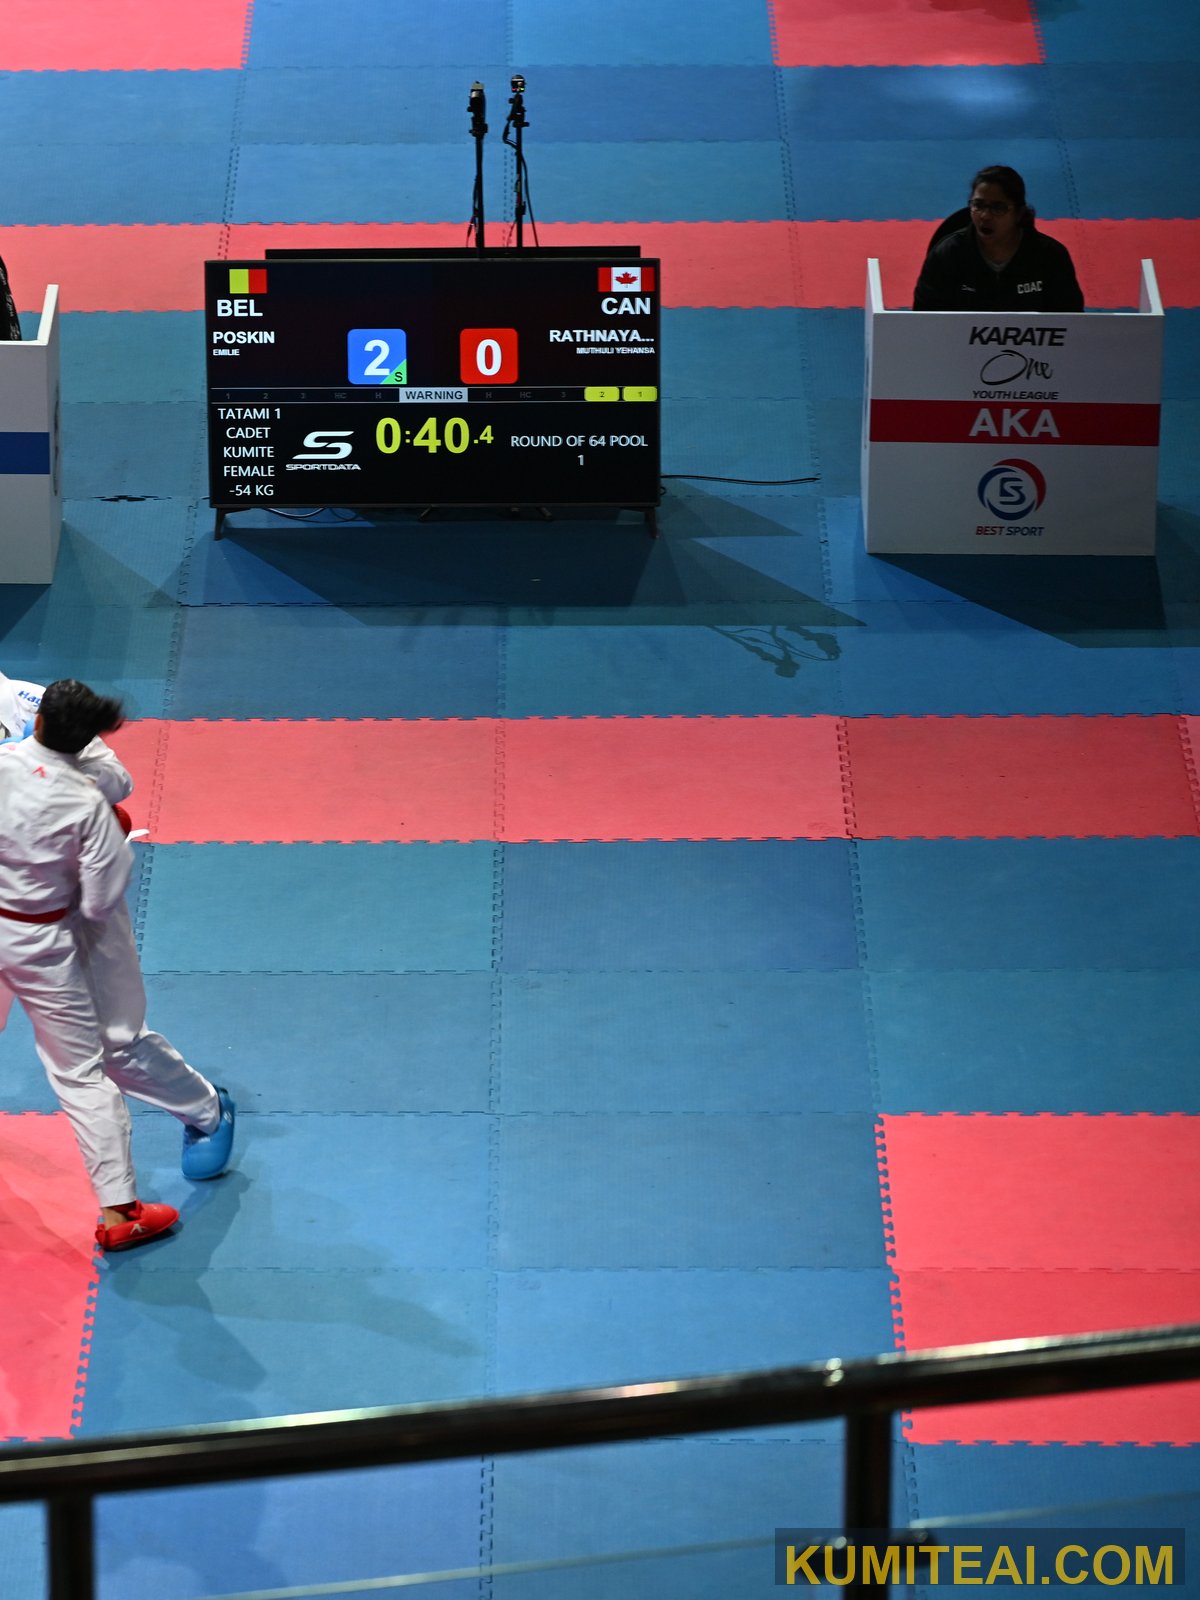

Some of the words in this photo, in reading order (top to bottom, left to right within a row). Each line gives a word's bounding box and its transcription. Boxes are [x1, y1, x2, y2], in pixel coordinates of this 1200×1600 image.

[216, 299, 263, 317] BEL
[601, 297, 651, 315] CAN
[212, 331, 275, 344] POSKIN
[549, 329, 655, 343] RATHNAYA...
[968, 326, 1067, 347] KARATE
[212, 348, 241, 356] EMILIE
[616, 346, 656, 355] YEHANSA
[363, 339, 392, 376] 2
[476, 338, 502, 376] 0
[980, 349, 1053, 386] One
[394, 371, 404, 383] S
[263, 392, 269, 400] 2
[405, 390, 463, 400] WARNING
[972, 390, 1011, 399] YOUTH
[1012, 391, 1059, 401] LEAGUE
[218, 408, 270, 420] TATAMI
[274, 407, 281, 419] 1
[968, 408, 1060, 438] AKA
[226, 427, 271, 439] CADET
[511, 435, 563, 447] ROUND
[566, 435, 586, 447] OF
[589, 435, 606, 447] 64
[609, 435, 649, 447] POOL
[223, 446, 275, 458] KUMITE
[577, 454, 585, 466] 1
[223, 465, 275, 477] FEMALE
[285, 463, 362, 471] SPORTDATA
[229, 484, 252, 496] -54
[255, 484, 274, 496] KG
[975, 526, 1005, 536] BEST
[1006, 526, 1045, 537] SPORT
